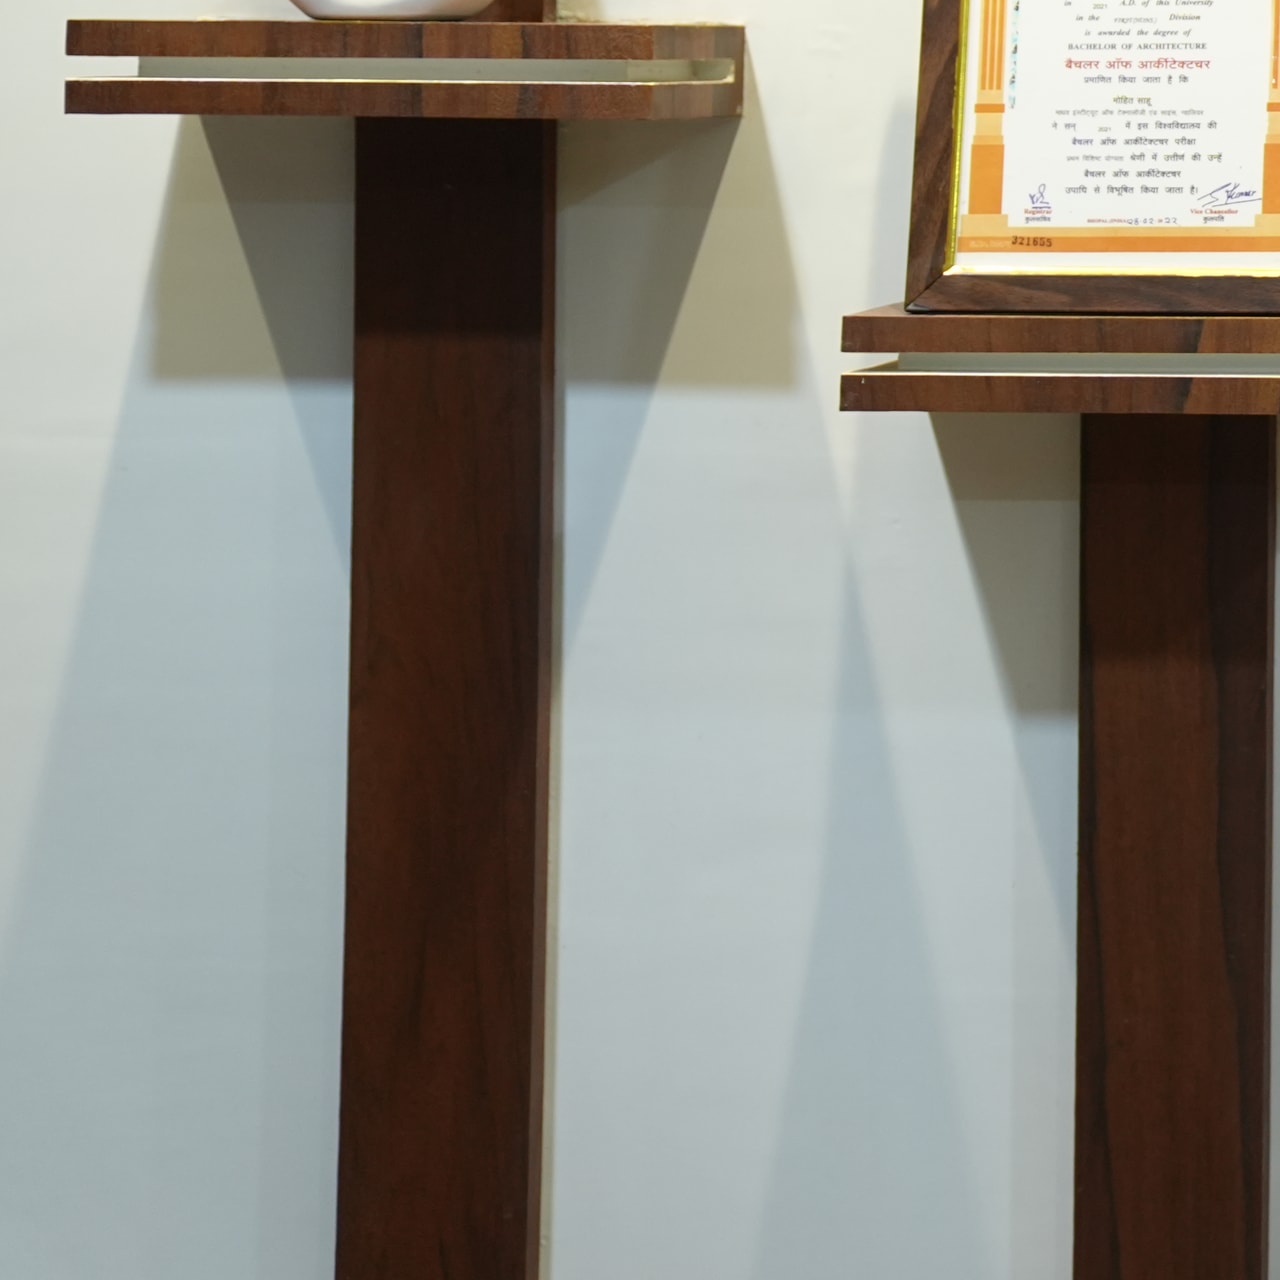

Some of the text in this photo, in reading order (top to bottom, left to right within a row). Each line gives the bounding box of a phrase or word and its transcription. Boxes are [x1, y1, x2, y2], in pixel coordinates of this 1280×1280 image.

[1065, 58, 1100, 69] बैचलर
[1105, 58, 1132, 69] ऑफ
[1012, 236, 1052, 247] 321655
